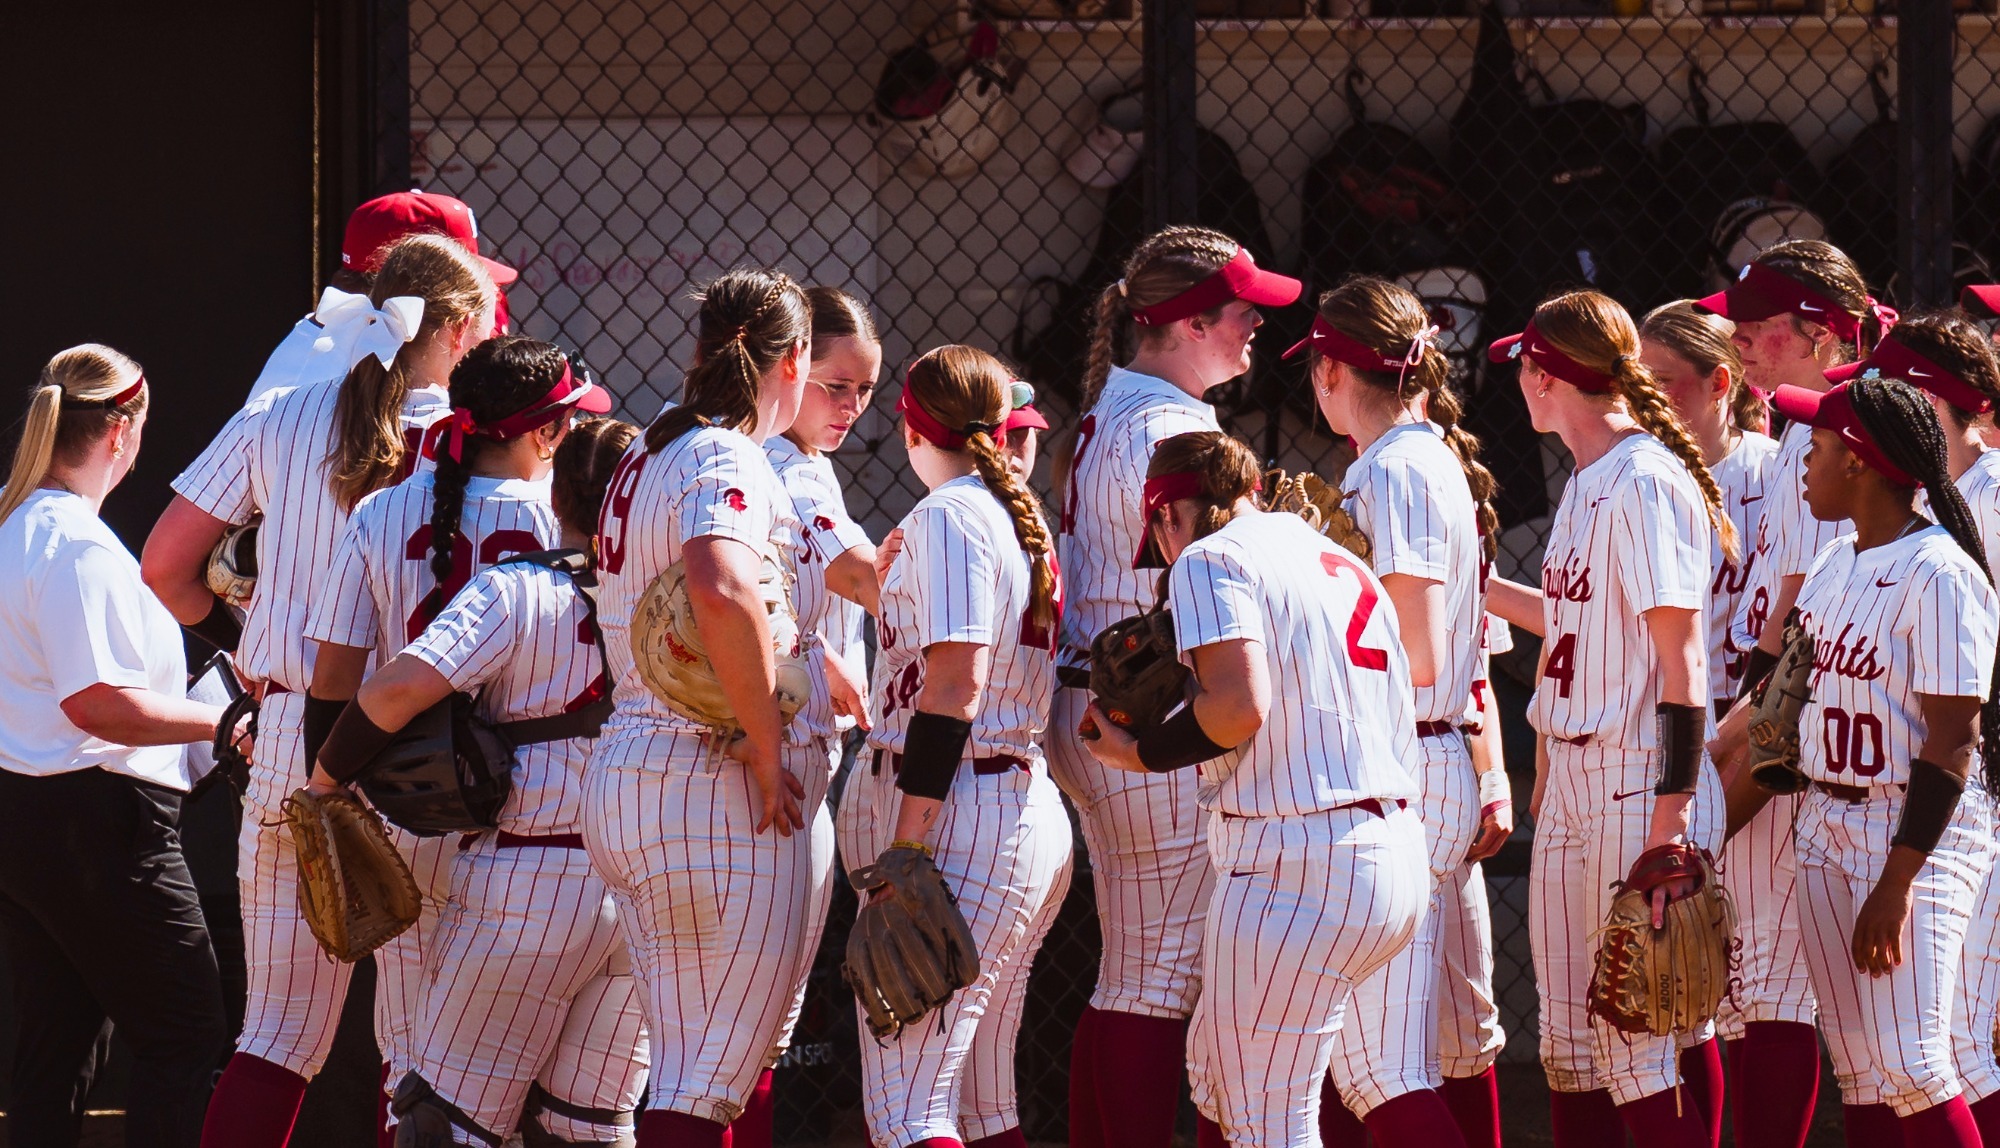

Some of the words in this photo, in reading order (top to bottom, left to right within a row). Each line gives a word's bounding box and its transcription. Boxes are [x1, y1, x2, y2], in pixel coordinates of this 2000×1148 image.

[1319, 551, 1387, 672] 2
[1823, 707, 1884, 776] 00
[1660, 973, 1670, 1012] A2000
